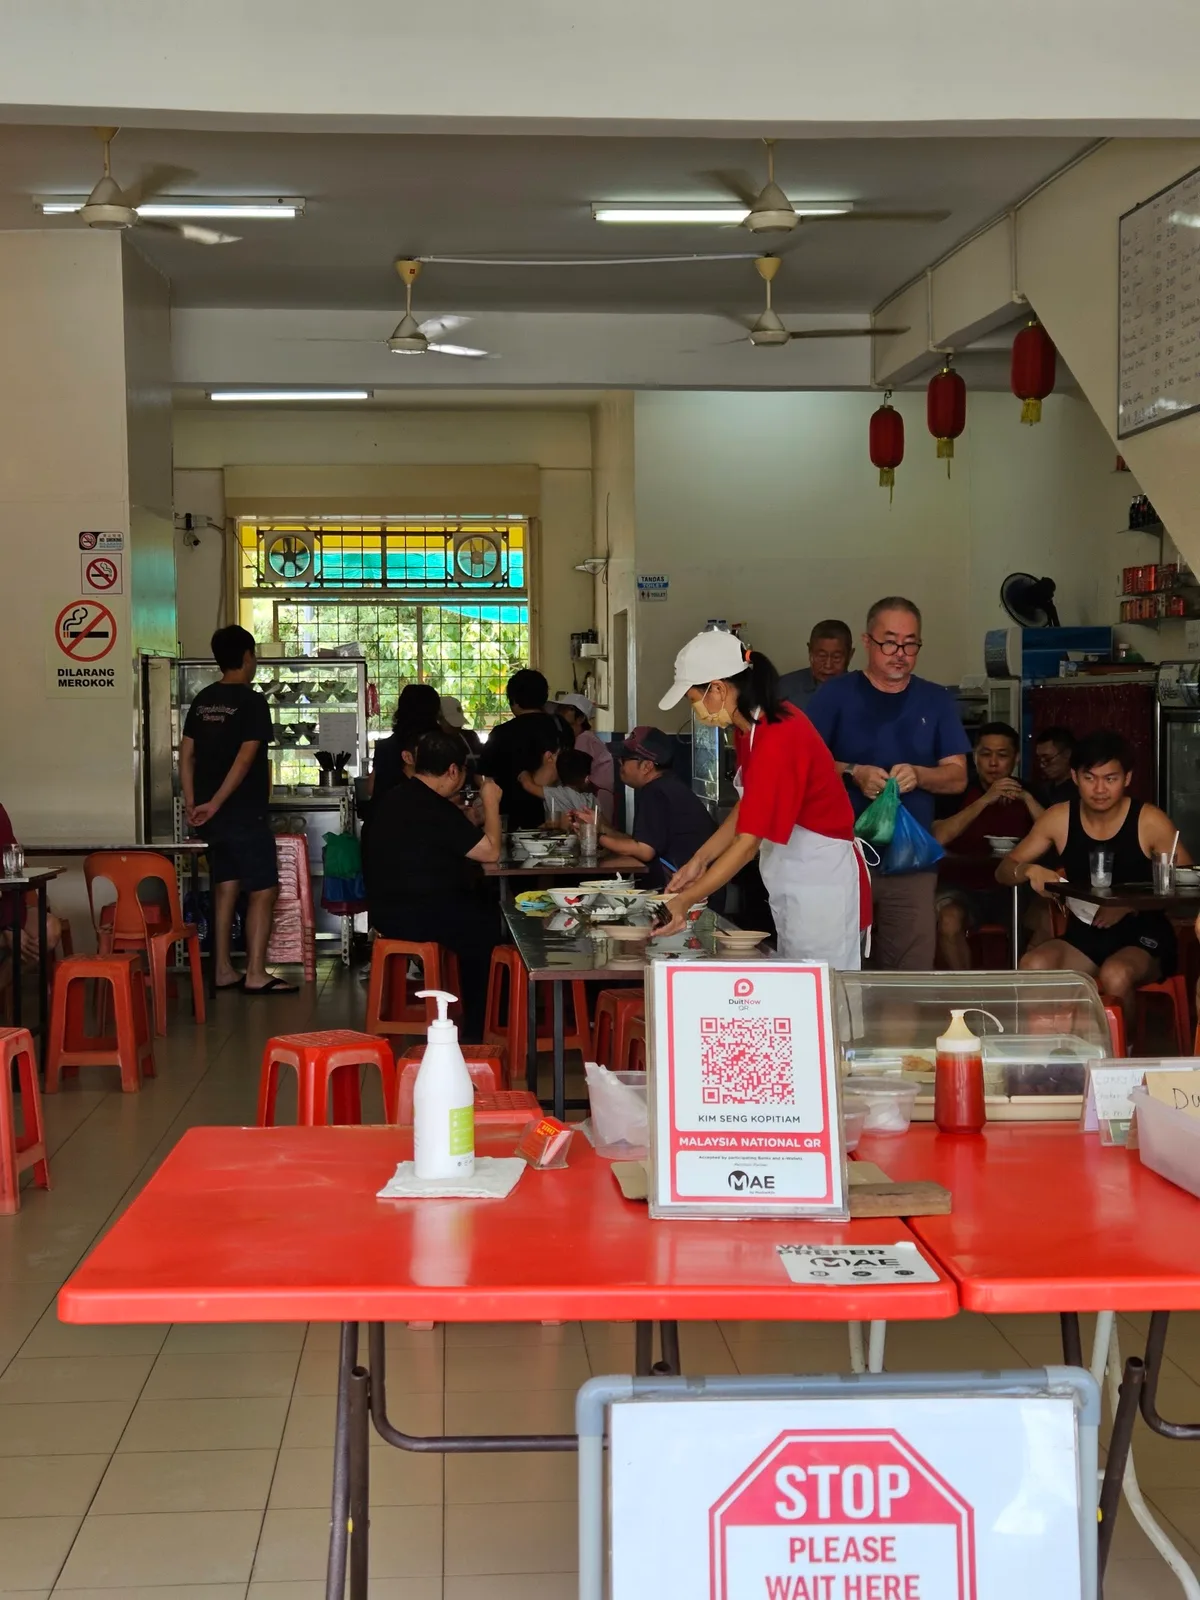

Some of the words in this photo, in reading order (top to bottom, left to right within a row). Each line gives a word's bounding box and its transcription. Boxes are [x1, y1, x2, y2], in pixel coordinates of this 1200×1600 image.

[57, 668, 115, 677] DILARANG
[58, 679, 115, 688] MEROKOK
[751, 1115, 800, 1123] KOPITIAM
[679, 1137, 738, 1147] MALAYSIA
[741, 1138, 800, 1147] NATIONAL
[803, 1138, 821, 1148] QR
[728, 1170, 775, 1191] MAE
[809, 1256, 900, 1267] MAE
[775, 1465, 910, 1520] STOP
[789, 1537, 897, 1563] PLEASE
[766, 1575, 836, 1600] WAIT
[843, 1575, 920, 1600] HERE
